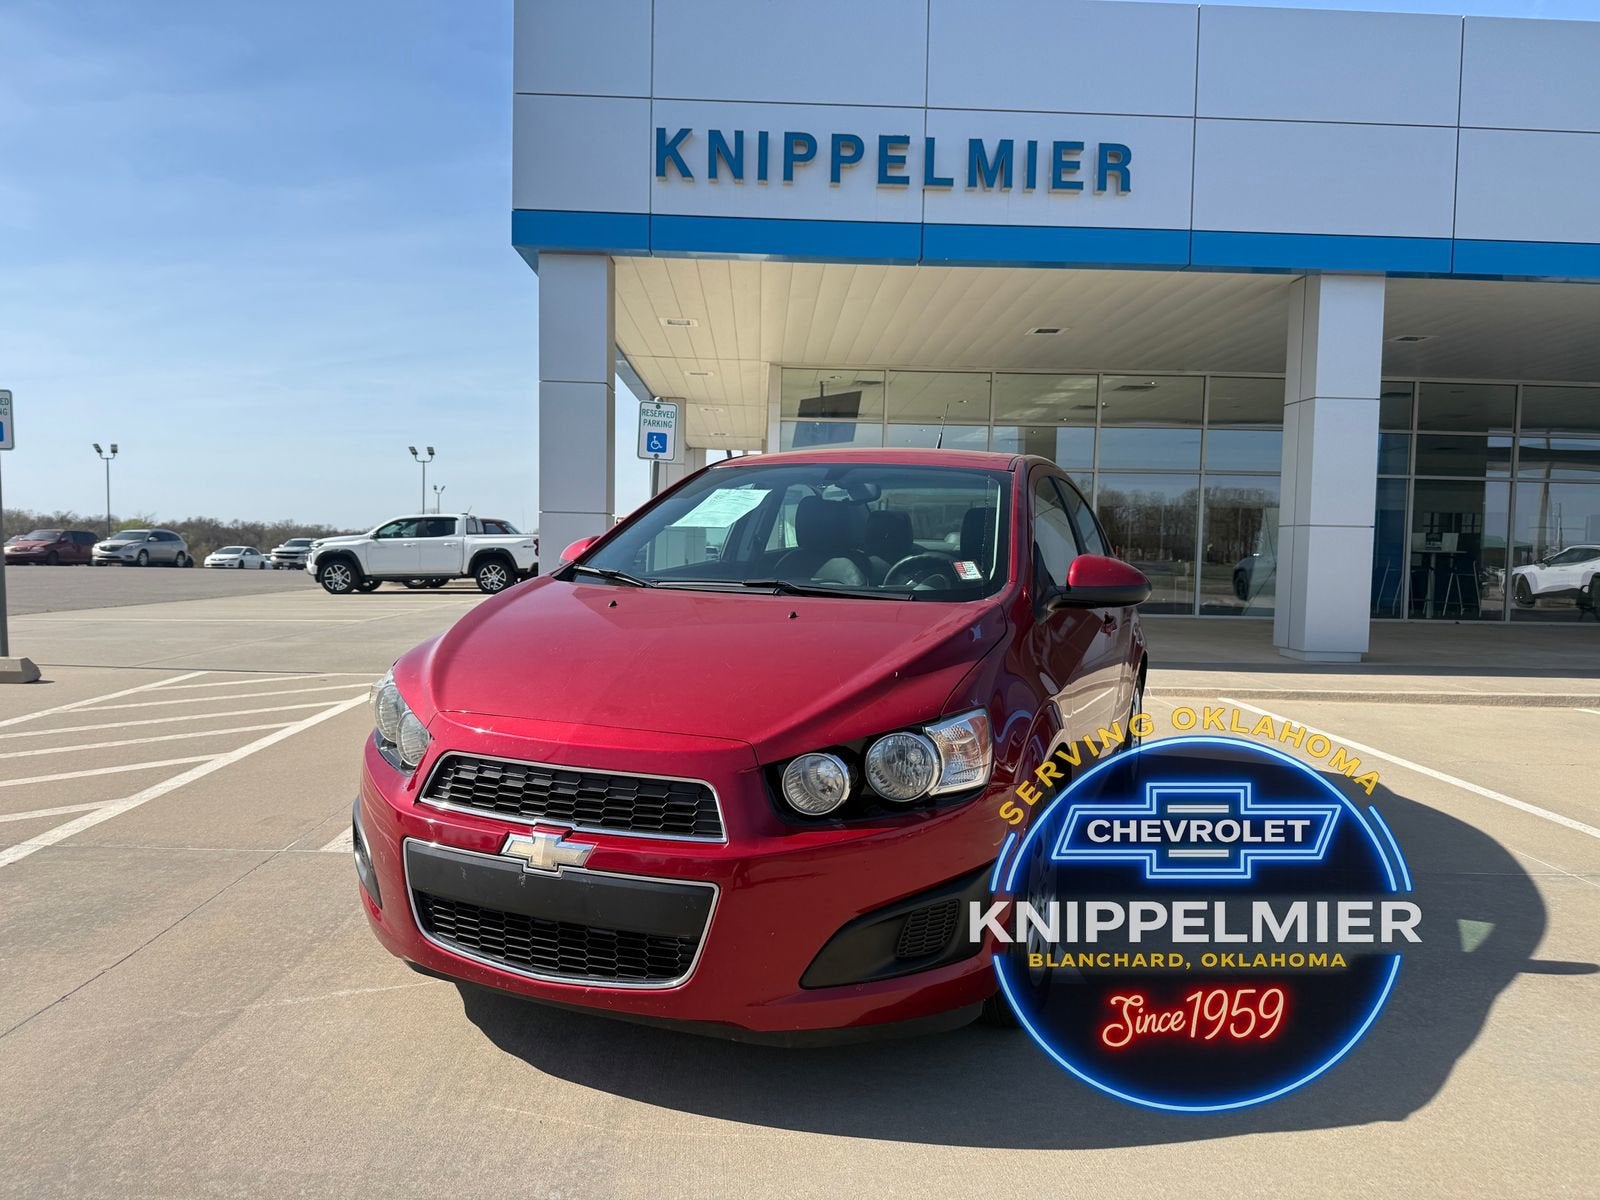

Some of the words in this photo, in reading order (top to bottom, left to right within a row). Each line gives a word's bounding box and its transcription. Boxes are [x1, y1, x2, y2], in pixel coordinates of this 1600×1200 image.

[655, 126, 1133, 194] KNIPPELMIER
[641, 408, 675, 419] RESERVED
[643, 418, 673, 428] PARKING
